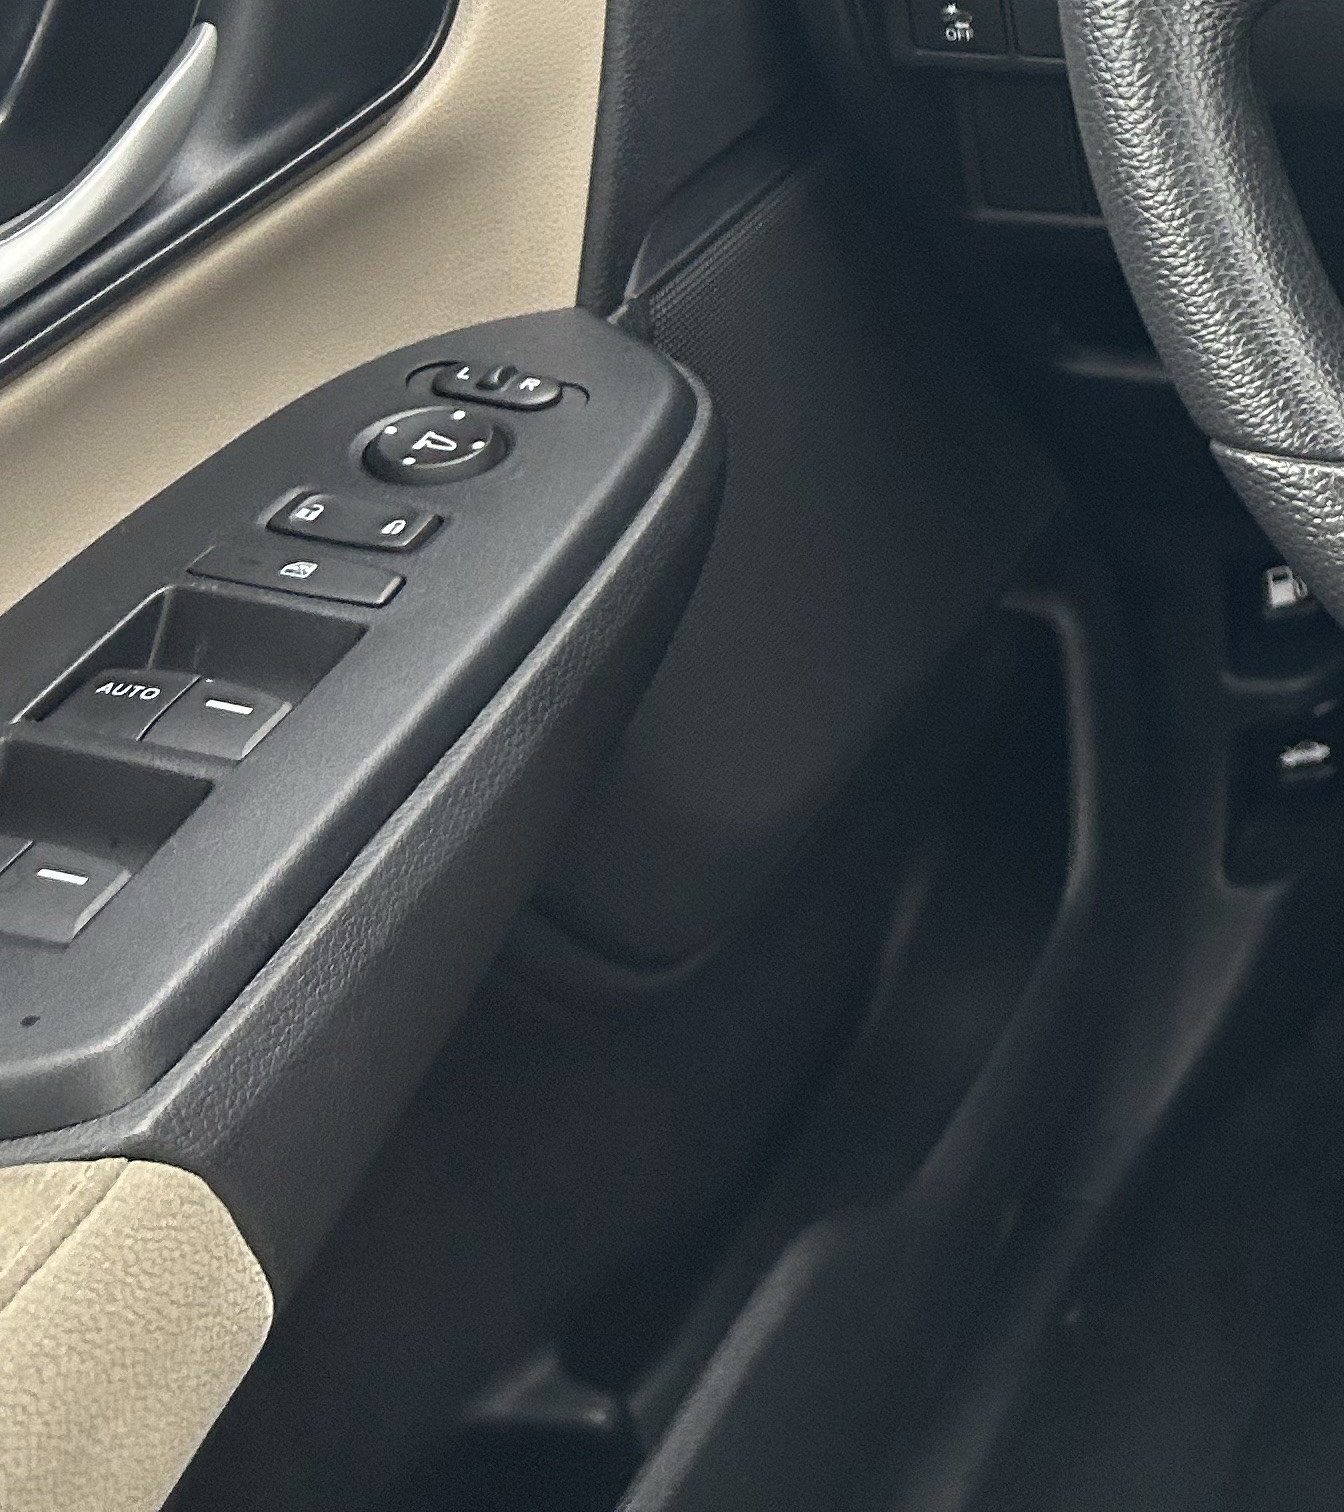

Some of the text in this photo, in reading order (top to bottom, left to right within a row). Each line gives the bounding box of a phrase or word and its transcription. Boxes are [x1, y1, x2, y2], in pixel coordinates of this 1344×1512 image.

[457, 367, 470, 380] L
[519, 377, 541, 391] R
[96, 681, 161, 702] AUTO
